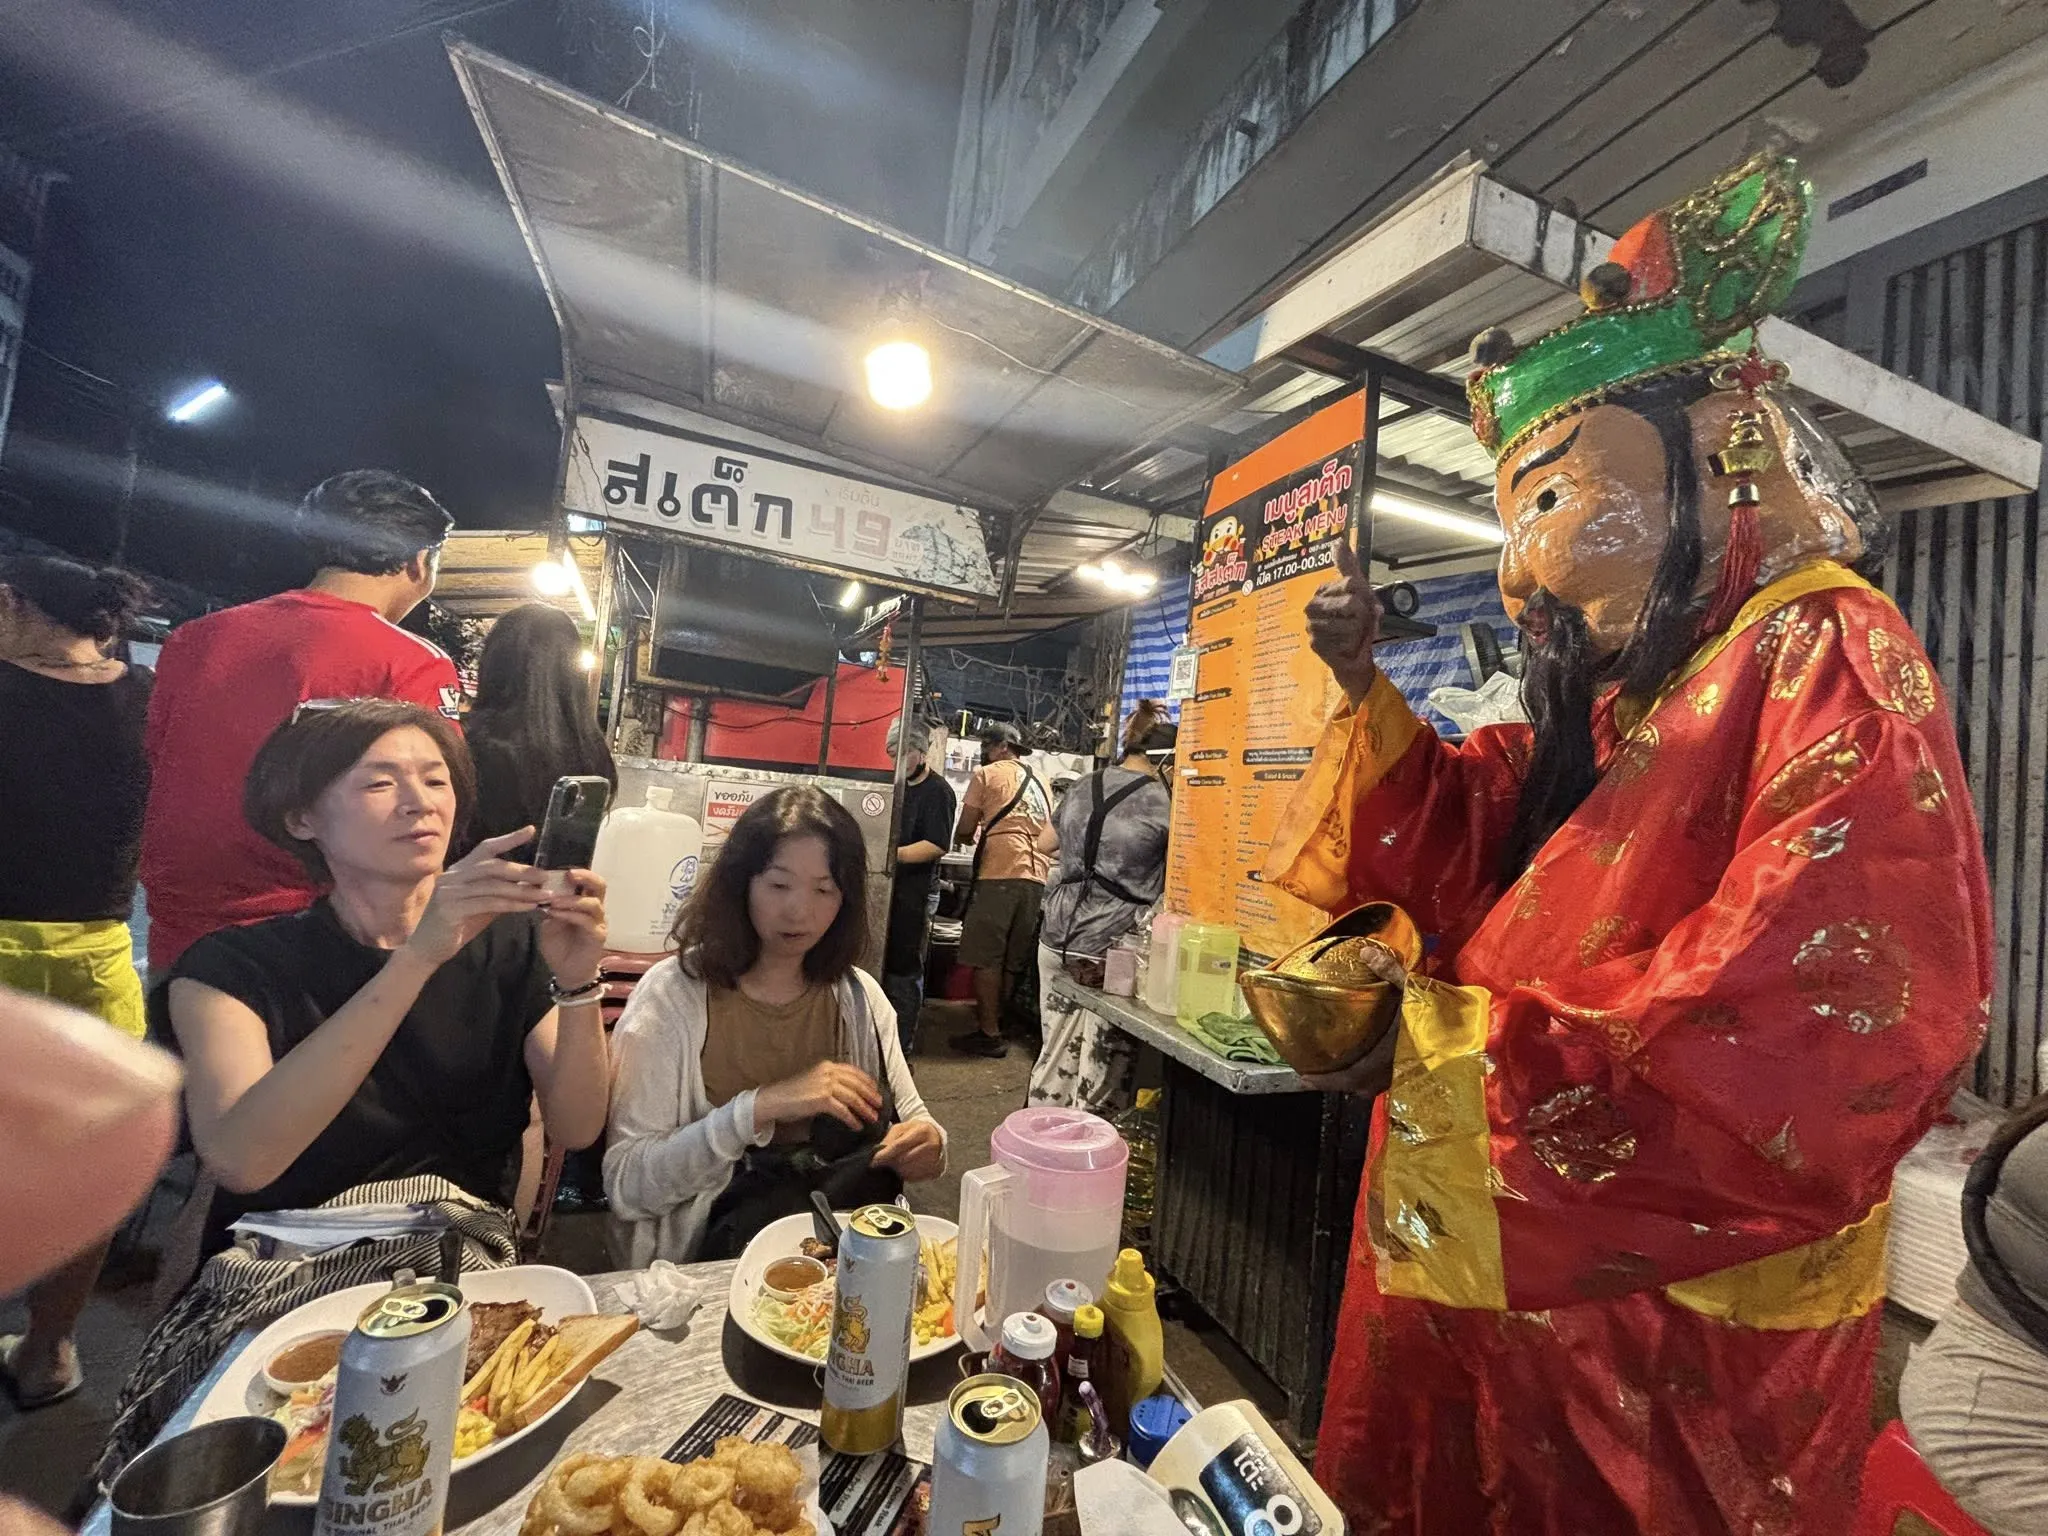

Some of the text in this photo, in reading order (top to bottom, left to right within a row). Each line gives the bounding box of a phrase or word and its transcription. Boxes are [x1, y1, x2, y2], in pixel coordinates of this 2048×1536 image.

[602, 452, 794, 542] สเต็ก
[1264, 458, 1352, 524] เมนูสเต็ก
[1262, 522, 1303, 552] STEAK
[1304, 503, 1348, 537] MENU
[1244, 1494, 1303, 1536] 8
